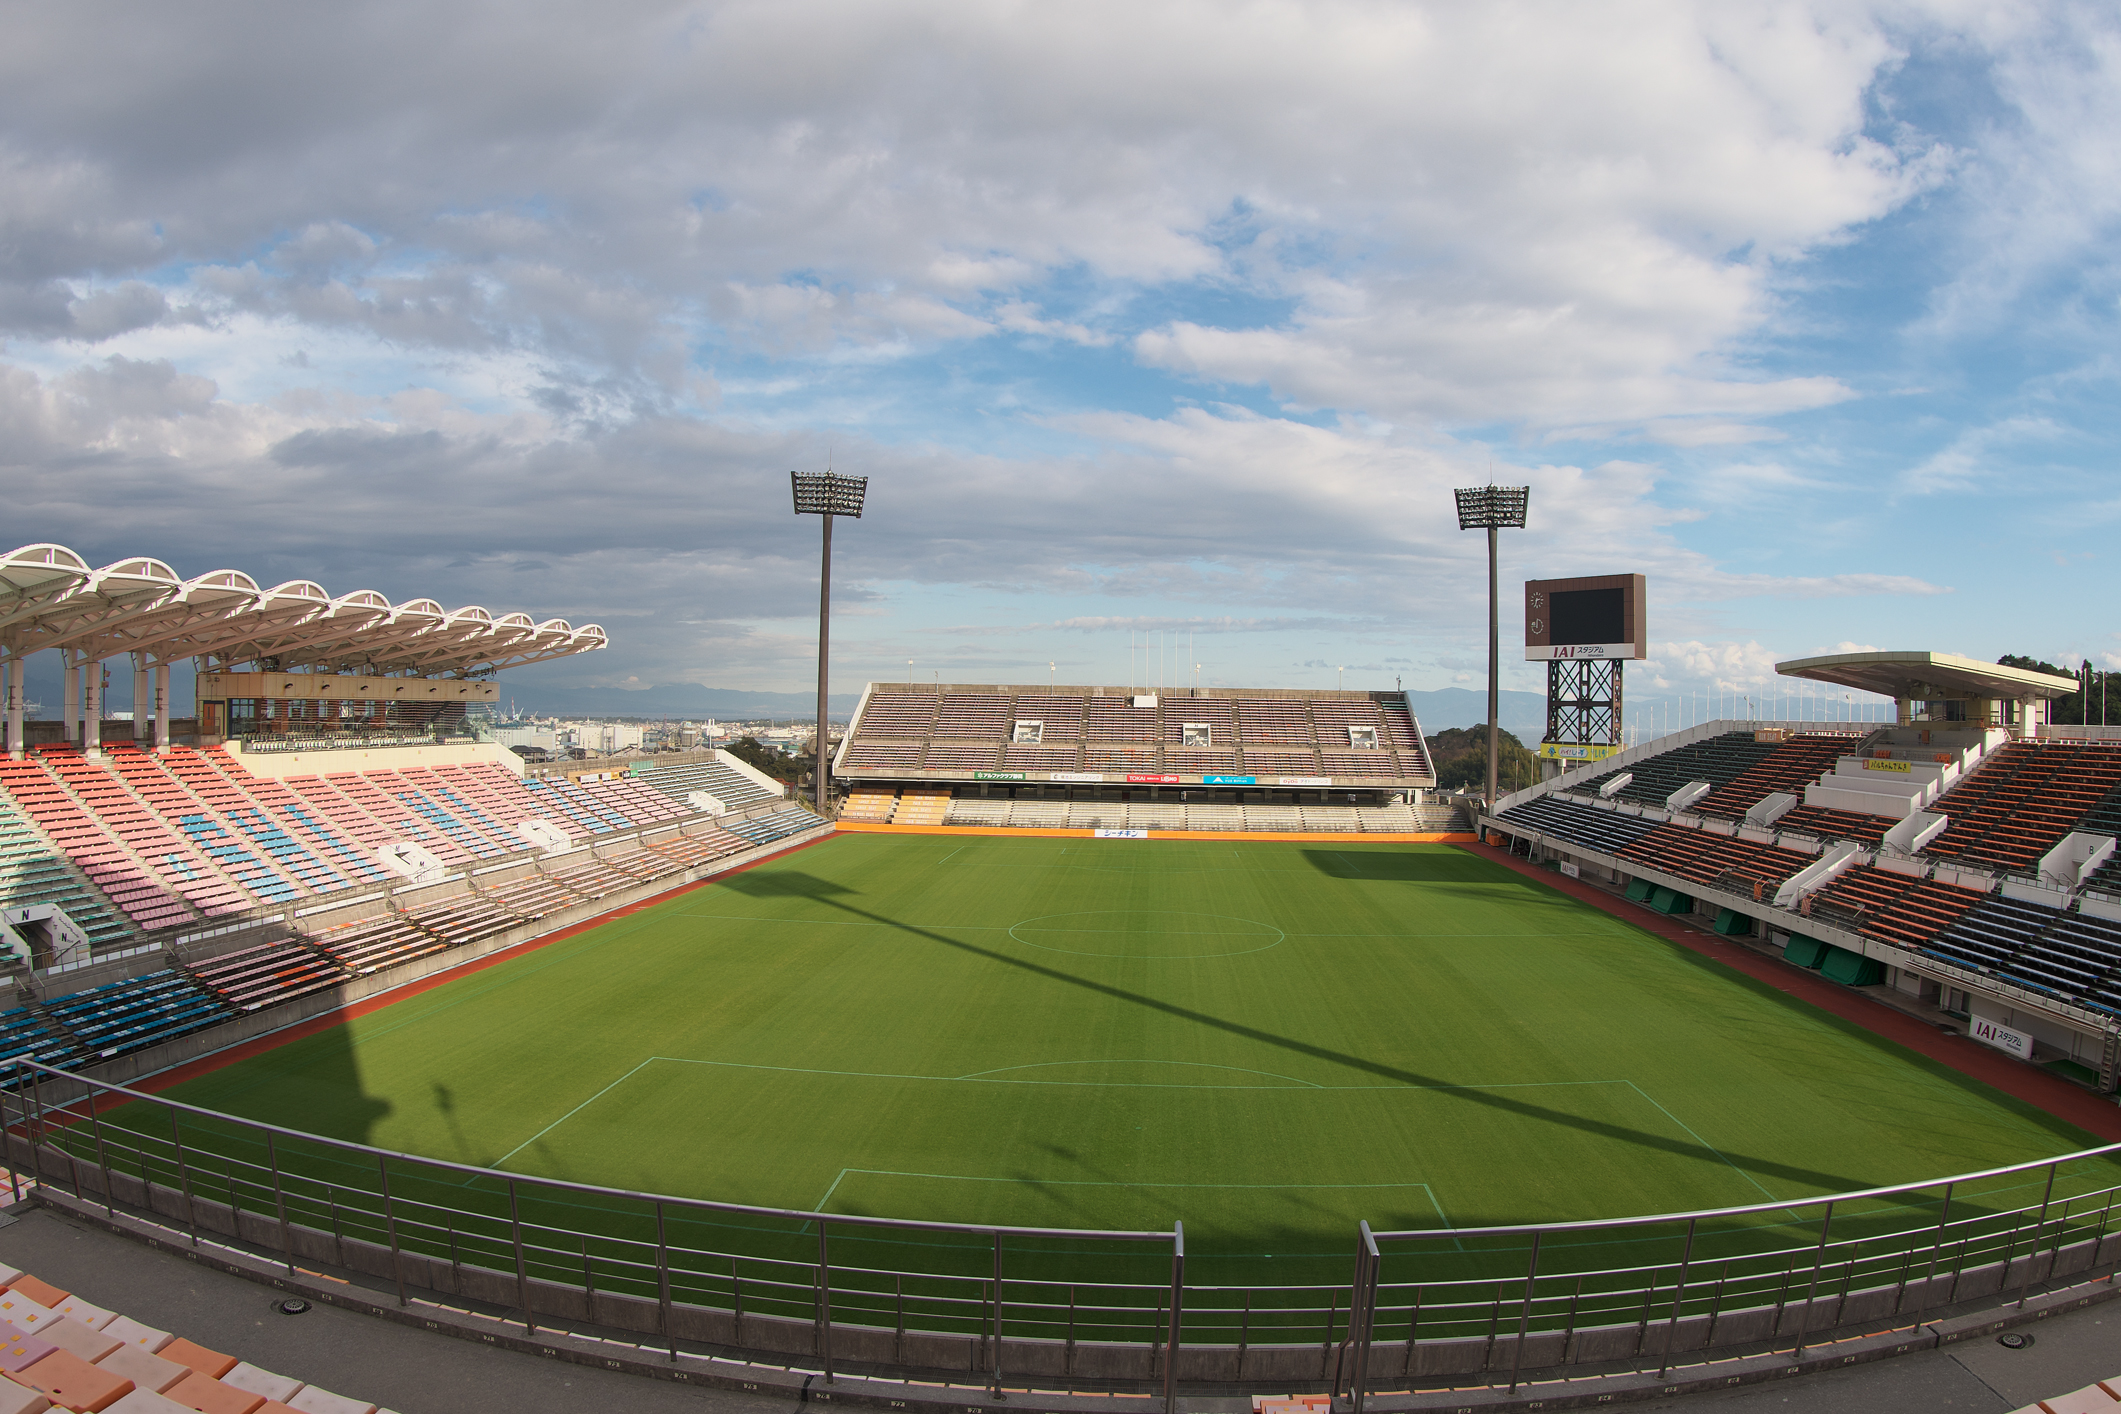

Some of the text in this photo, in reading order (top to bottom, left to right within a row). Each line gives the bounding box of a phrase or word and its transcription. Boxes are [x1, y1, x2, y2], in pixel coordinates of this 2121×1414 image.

[1553, 646, 1604, 658] IAI スタジアム
[1104, 829, 1139, 837] シーチキン
[2088, 845, 2095, 855] B
[21, 909, 30, 921] N
[61, 932, 68, 942] N
[1976, 1021, 2022, 1047] IAI スタジアム
